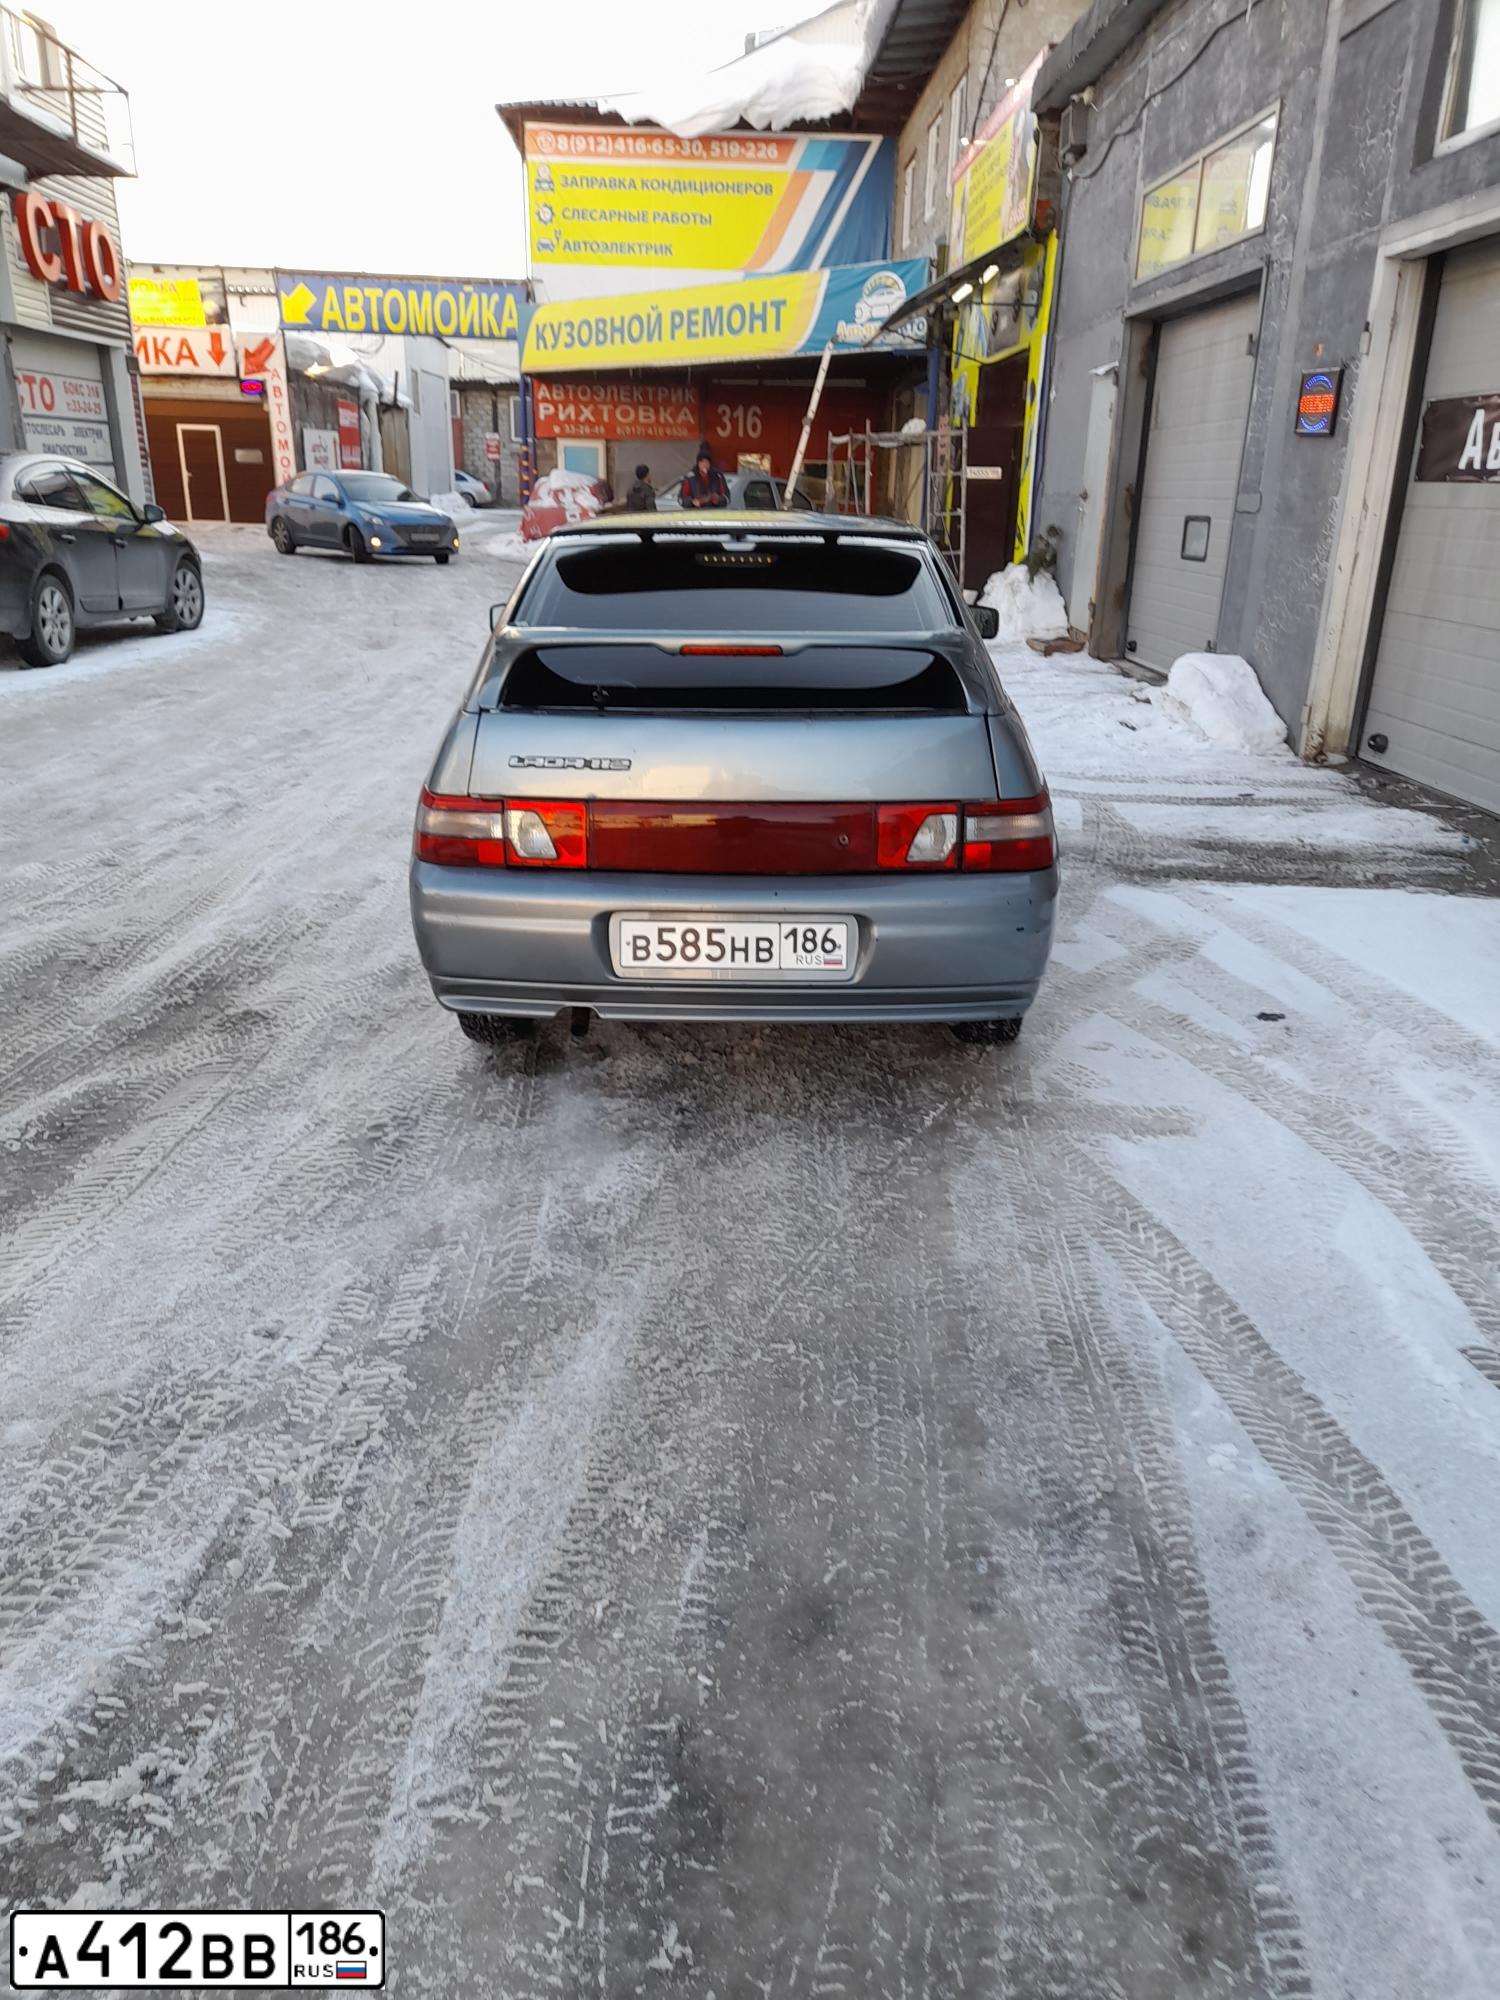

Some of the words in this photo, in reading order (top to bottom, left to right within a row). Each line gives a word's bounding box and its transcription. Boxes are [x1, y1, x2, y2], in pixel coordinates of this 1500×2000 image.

[561, 175, 637, 191] ЗАПРАВКА
[641, 179, 773, 196] КОНДИЦИОНЕРОВ
[562, 207, 649, 224] СЛЕСАРНЫЕ
[652, 211, 713, 226] РАБОТЫ
[15, 191, 121, 301] СТО
[562, 239, 674, 257] АВТОЭЛЕКТРИК
[321, 285, 518, 338] АВТОМОЙКА
[535, 305, 663, 351] КУЗОВНОЙ
[670, 299, 788, 341] РЕМОНТ
[537, 384, 697, 404] АВТОЭЛЕКТРИК
[537, 402, 696, 424] РИХТОВКА
[716, 404, 763, 438] 316
[631, 926, 774, 963] В585НВ
[783, 927, 838, 954] 186
[795, 954, 823, 966] RUS
